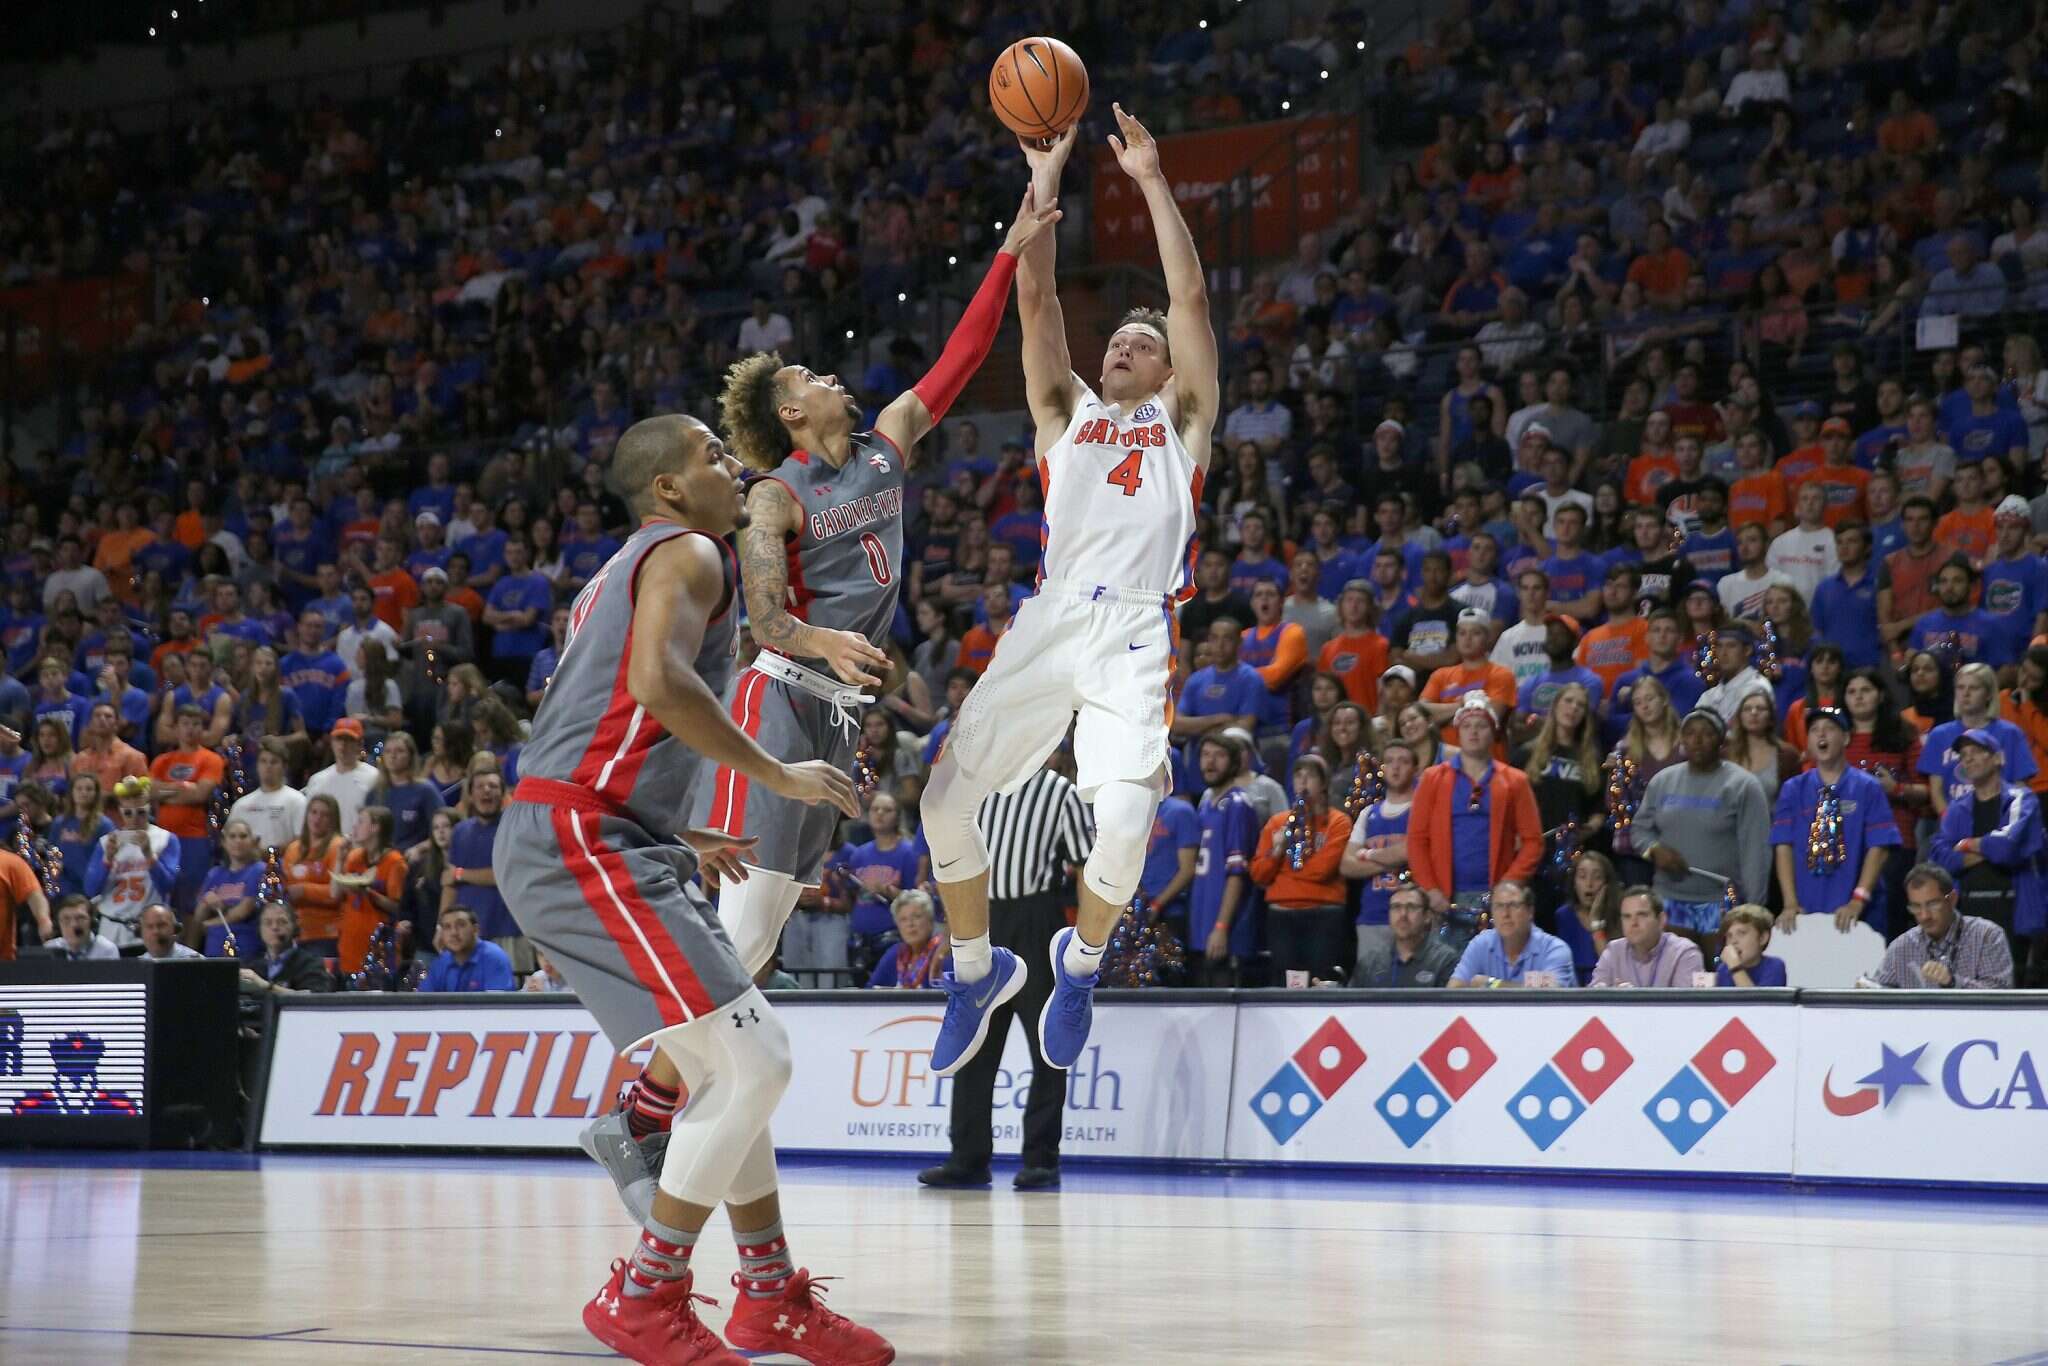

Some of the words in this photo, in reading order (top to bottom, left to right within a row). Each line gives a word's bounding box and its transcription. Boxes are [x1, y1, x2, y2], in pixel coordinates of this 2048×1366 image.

[1135, 404, 1154, 419] SEC
[1074, 418, 1167, 448] GATORS
[1107, 449, 1144, 496] 4
[859, 532, 892, 587] 0
[1092, 585, 1106, 601] F
[312, 1031, 691, 1118] REPTILE
[1942, 1038, 2048, 1110] CA
[847, 1121, 942, 1138] UNIVERSITY
[1064, 1126, 1117, 1142] EALTH
